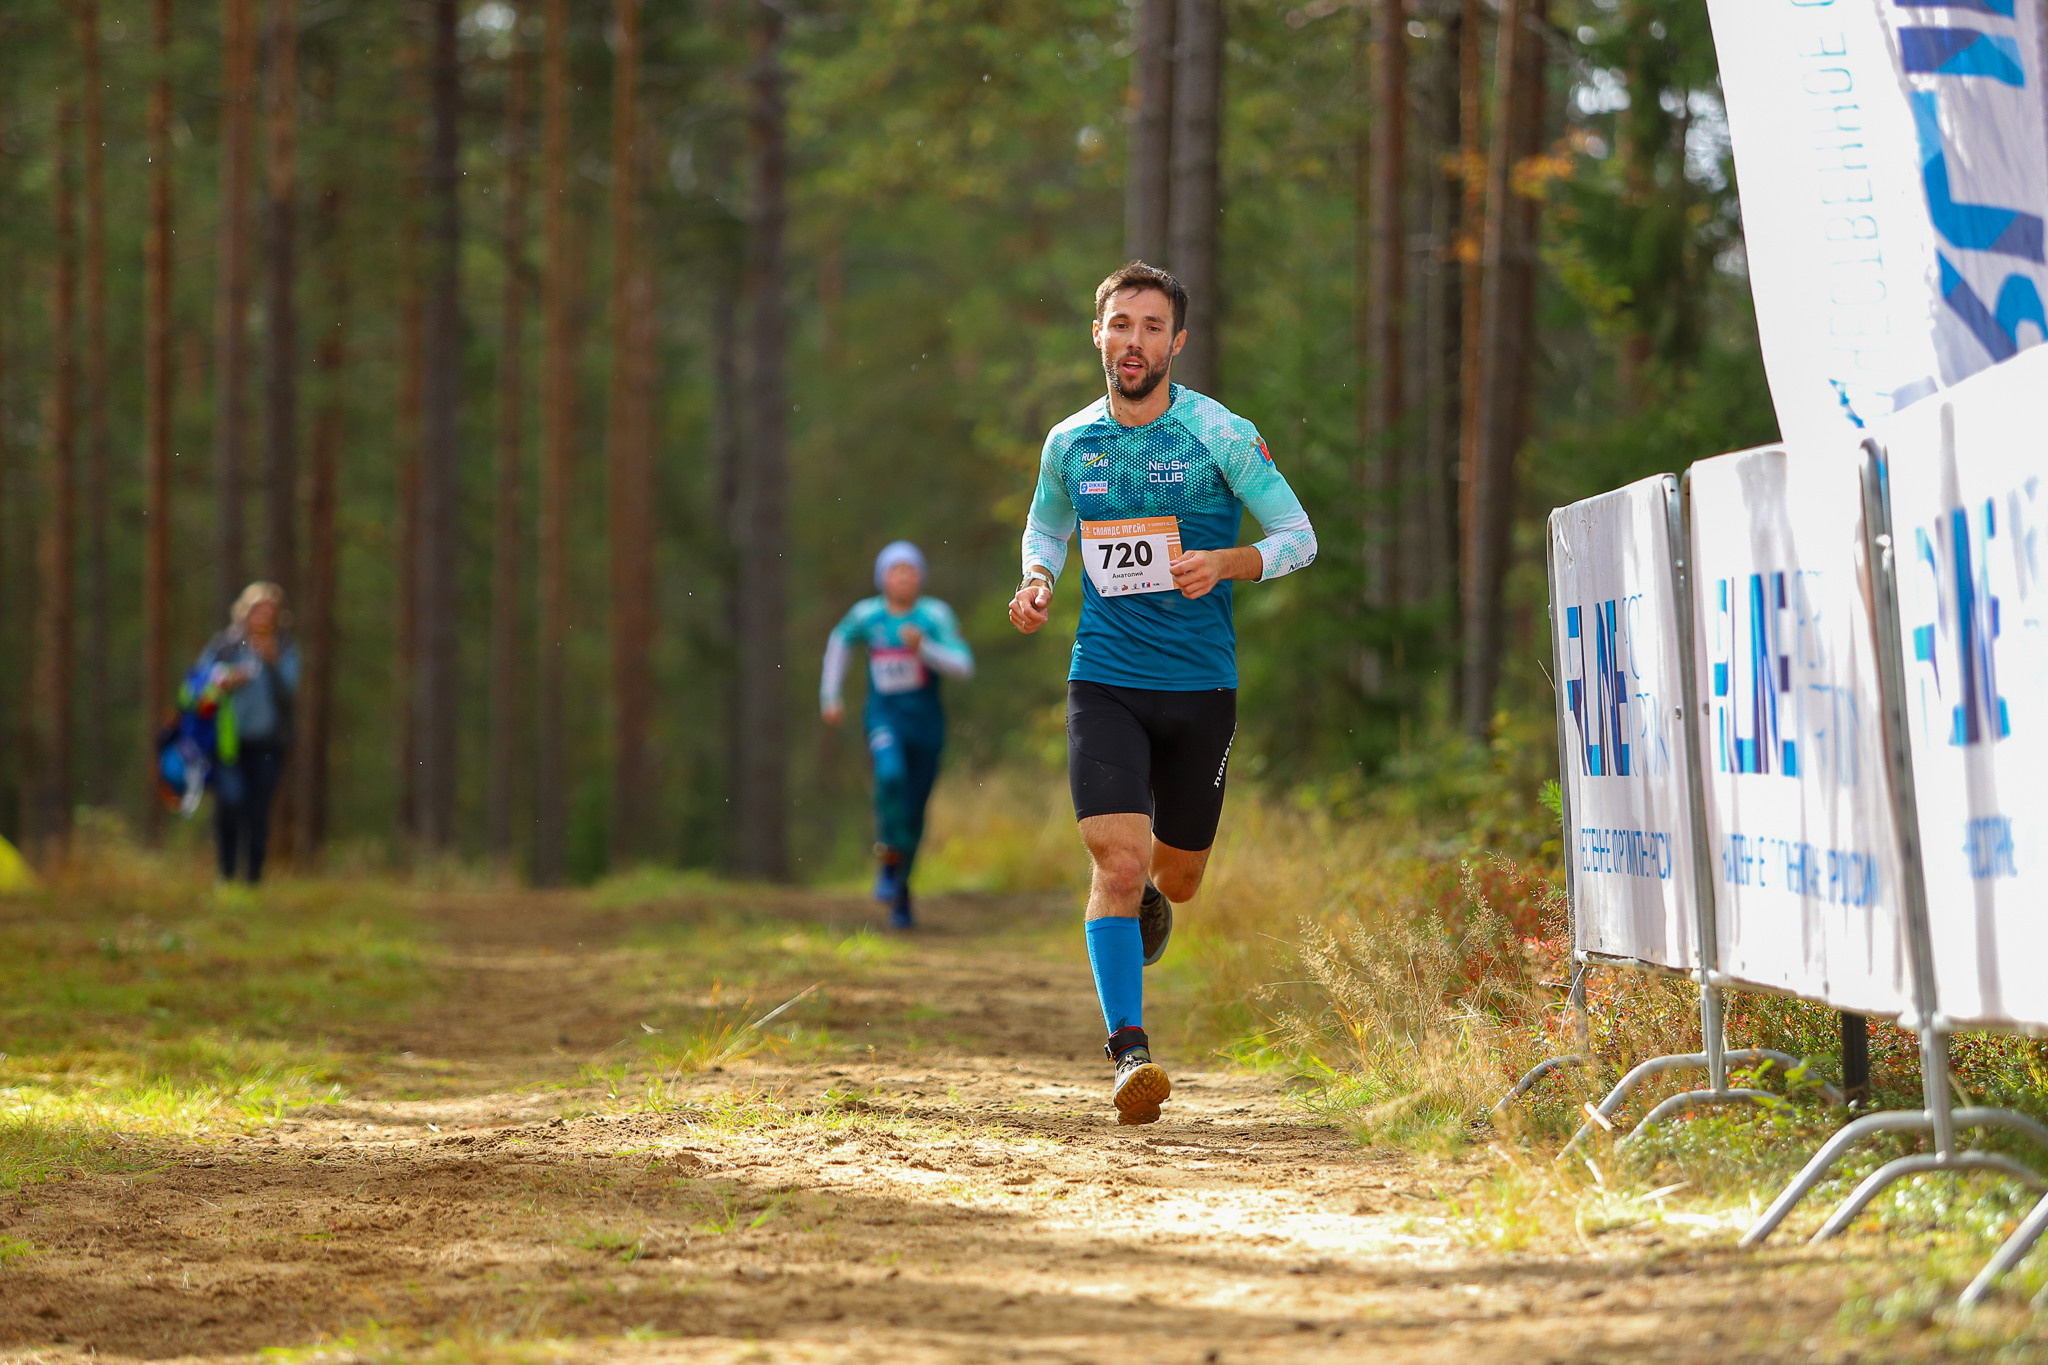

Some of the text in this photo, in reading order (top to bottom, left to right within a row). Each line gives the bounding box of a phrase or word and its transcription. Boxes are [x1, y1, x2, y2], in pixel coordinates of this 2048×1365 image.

[1092, 458, 1109, 467] LAB
[1149, 471, 1184, 483] CLUB
[1121, 522, 1146, 534] ТРЕЙЛ
[1098, 540, 1153, 570] 720
[1112, 570, 1144, 580] Анатолий
